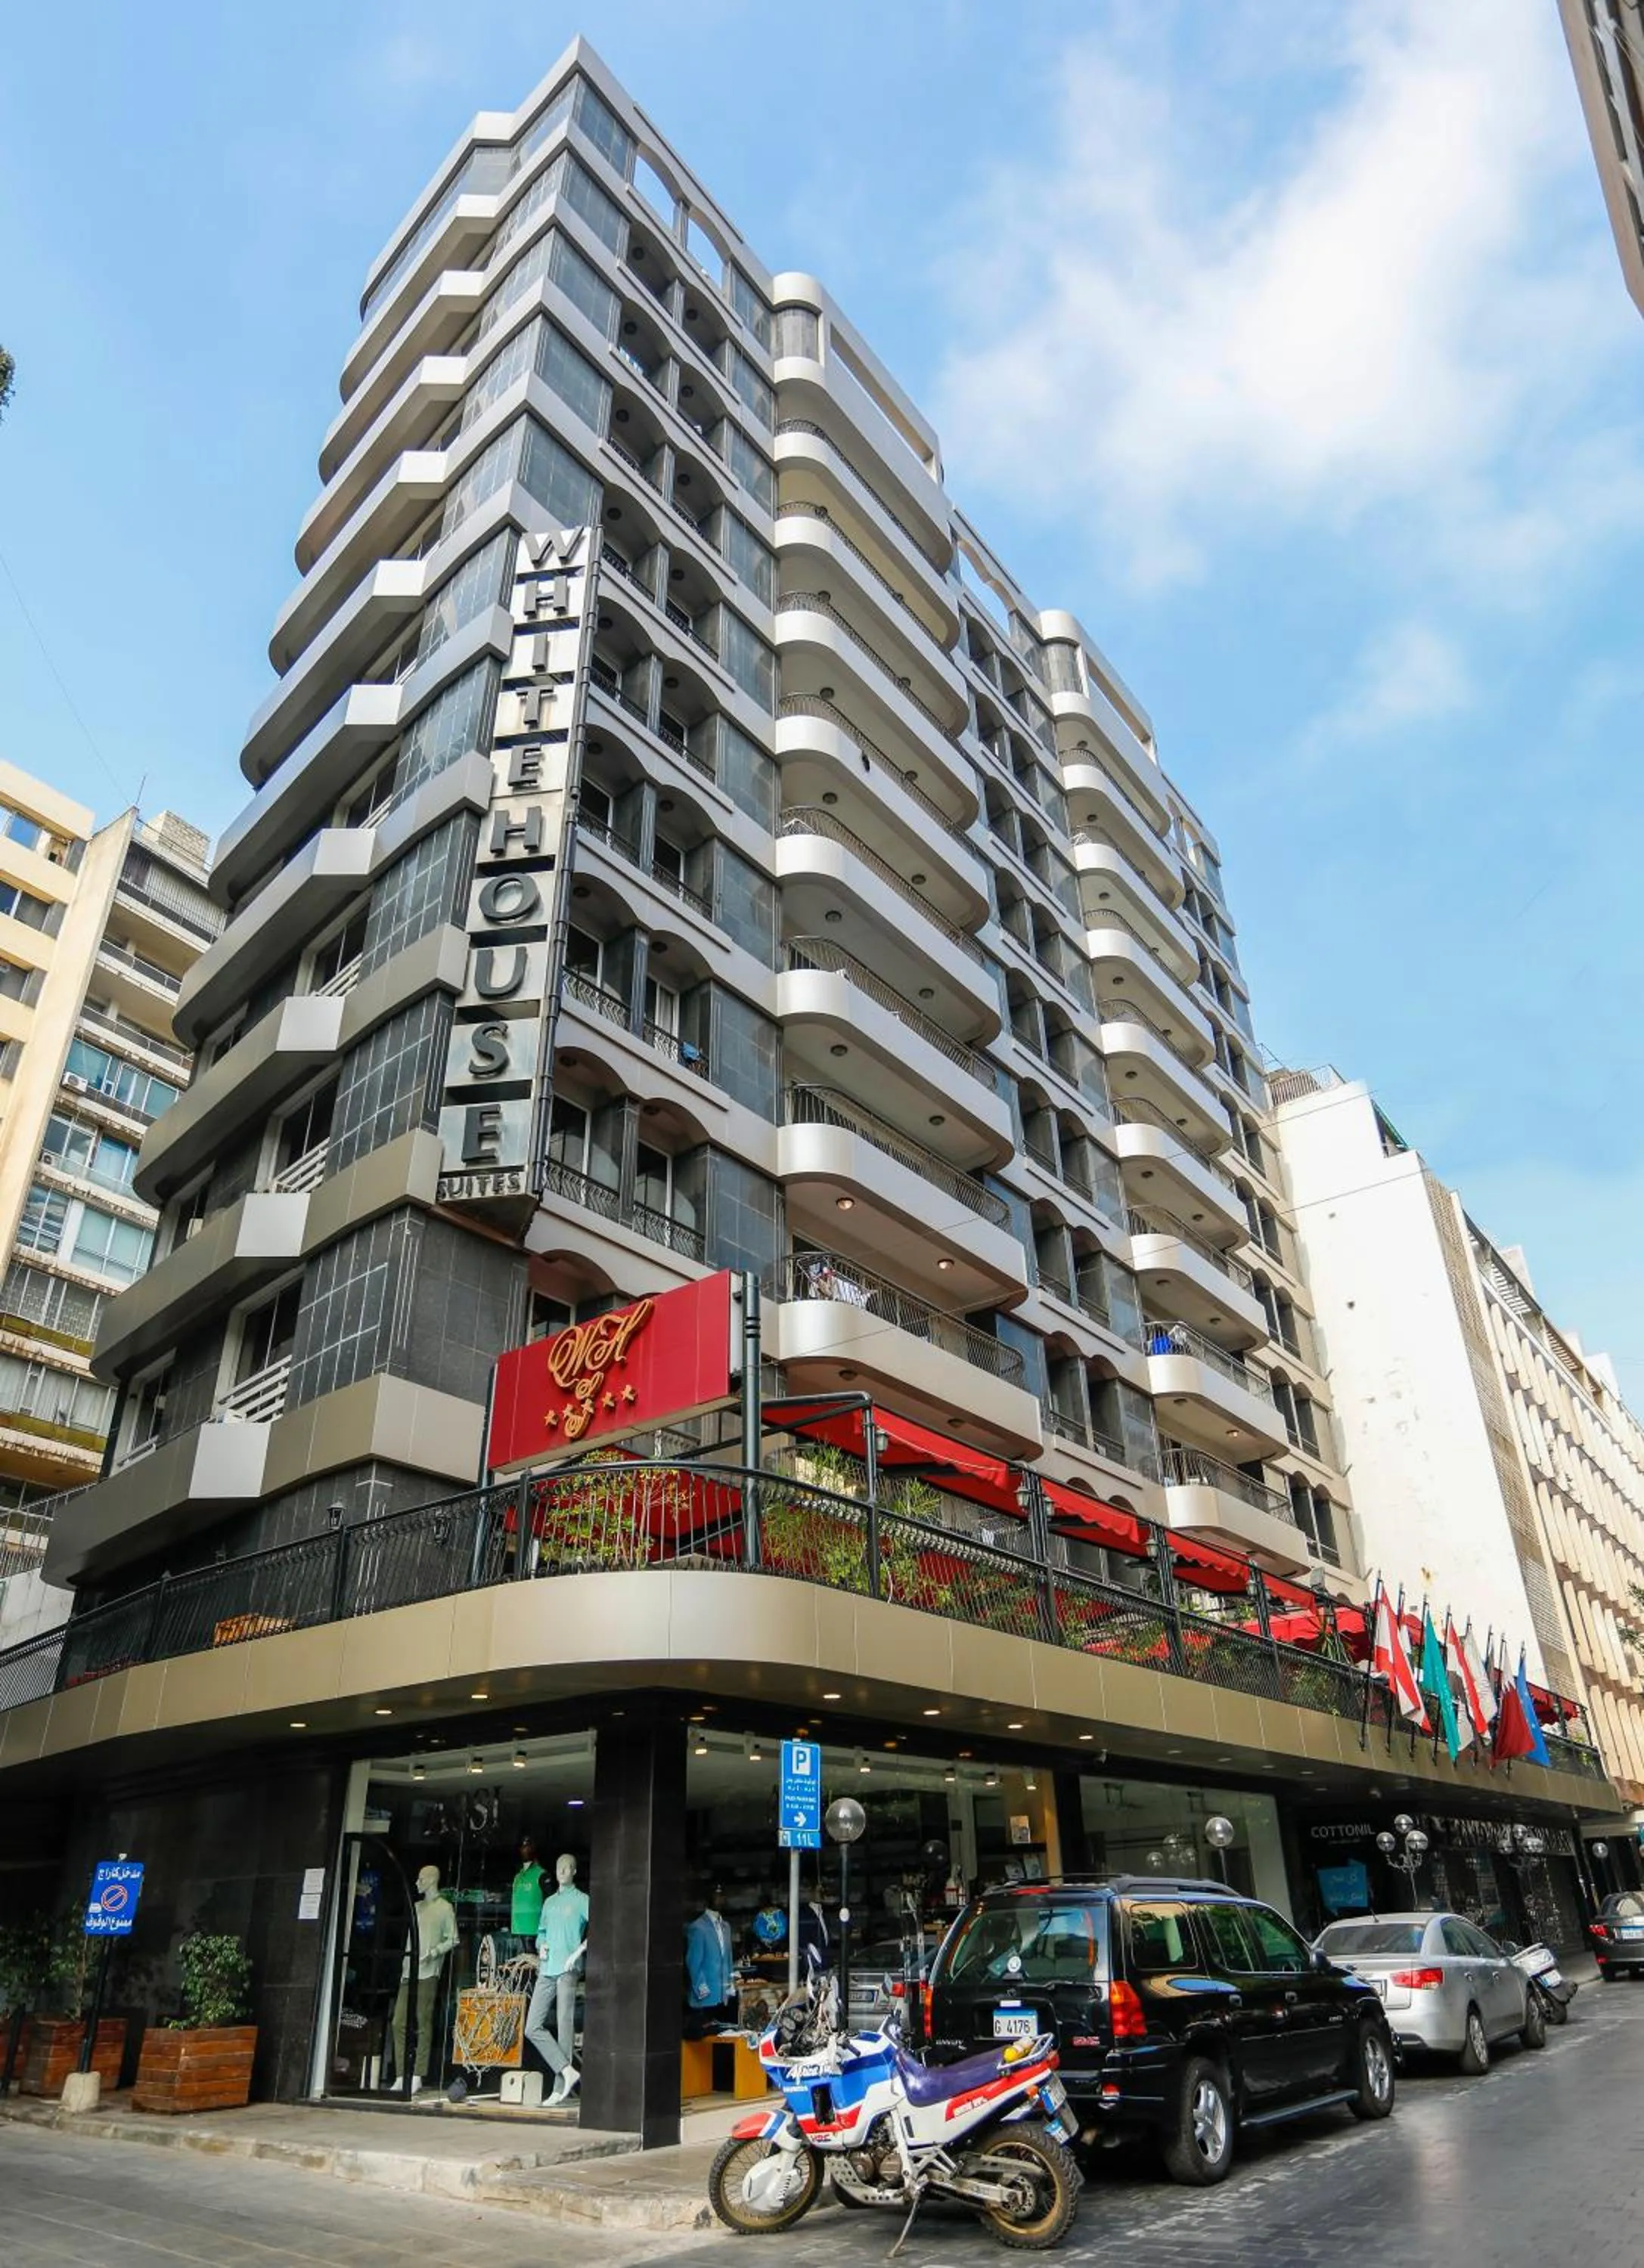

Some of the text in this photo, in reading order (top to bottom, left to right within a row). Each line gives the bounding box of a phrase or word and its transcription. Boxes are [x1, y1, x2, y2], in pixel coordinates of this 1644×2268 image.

[436, 1173, 521, 1200] SUITES
[796, 1750, 808, 1771] P
[1311, 1821, 1376, 1838] COTTONIL
[994, 2019, 1031, 2034] G 4176
